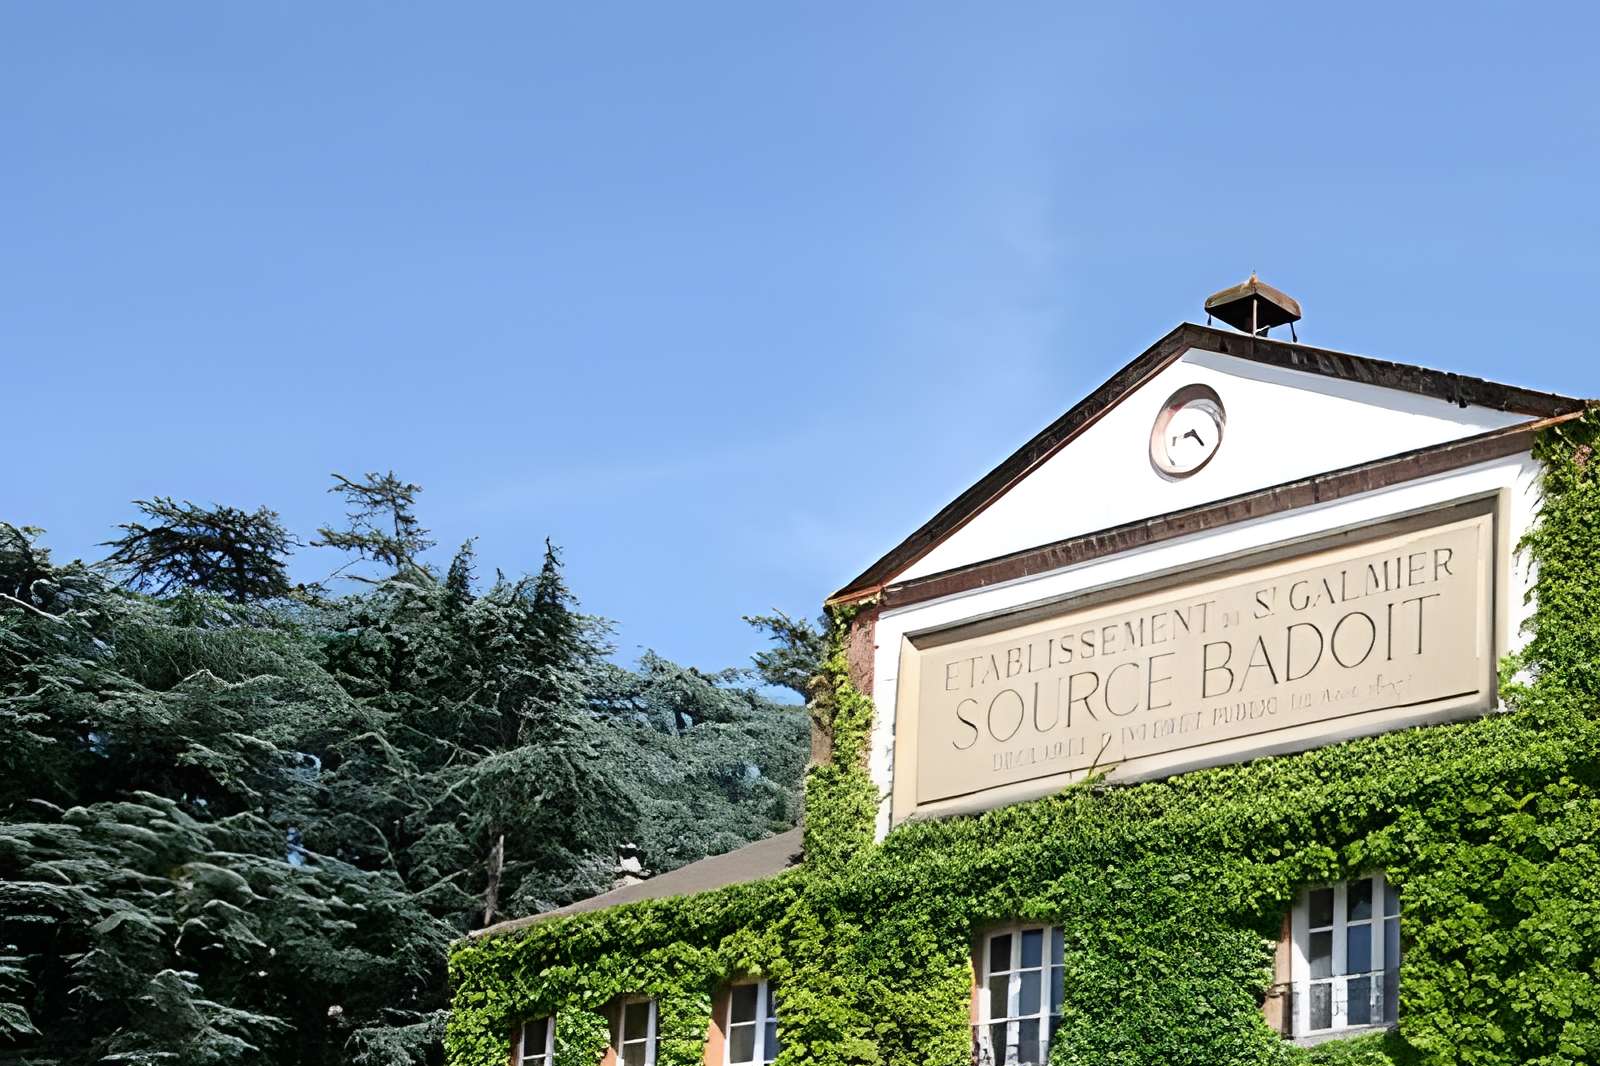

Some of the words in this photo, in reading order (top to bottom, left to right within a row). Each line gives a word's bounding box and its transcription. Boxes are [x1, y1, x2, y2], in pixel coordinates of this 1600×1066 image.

[945, 600, 1216, 691] ETABLISSEMENT
[1289, 548, 1453, 612] GALMIER
[952, 651, 1176, 751] SOURCE
[1202, 593, 1441, 699] BADOIT
